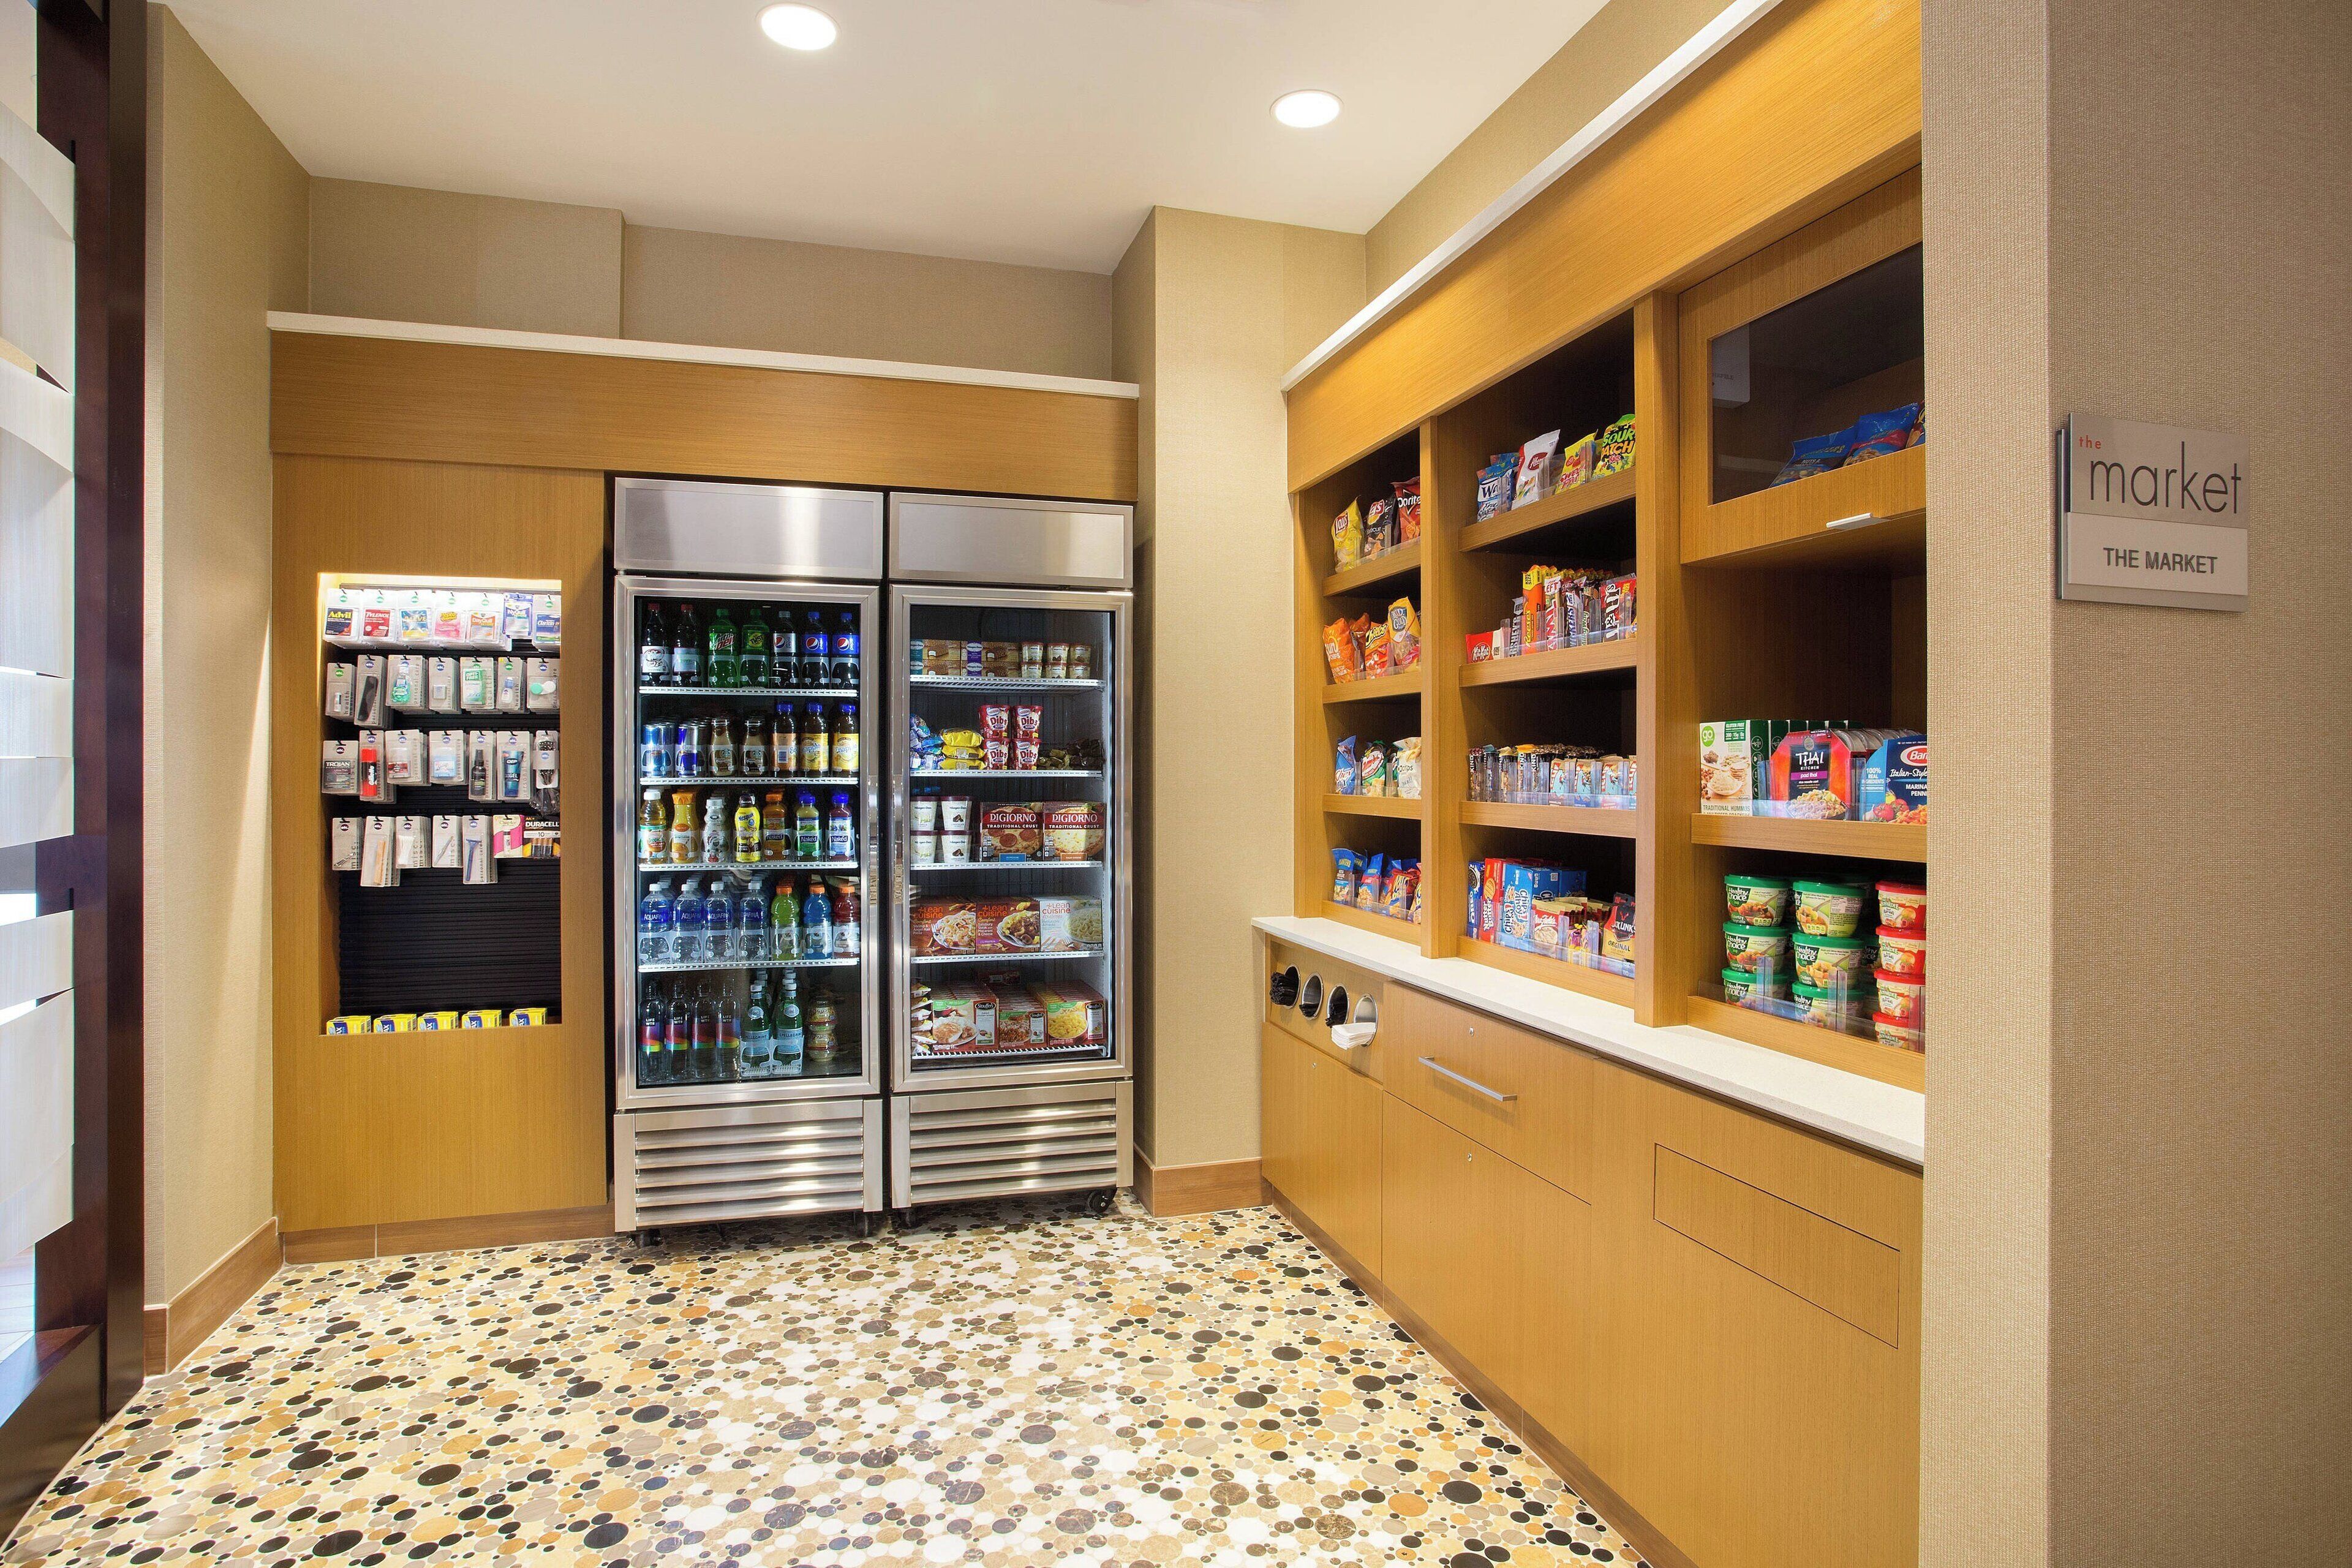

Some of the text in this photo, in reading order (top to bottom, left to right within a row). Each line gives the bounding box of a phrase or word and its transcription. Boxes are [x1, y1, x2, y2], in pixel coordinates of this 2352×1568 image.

[1603, 428, 1635, 447] SOUR
[2079, 435, 2101, 449] the
[2090, 441, 2241, 514] market
[1397, 495, 1421, 508] Dorito
[2103, 548, 2218, 575] THE MARKET
[1547, 581, 1559, 592] EFT
[990, 715, 1008, 726] Dibs
[1021, 716, 1038, 726] Dibs
[1703, 730, 1713, 742] go
[990, 749, 1008, 759] Dibs
[1020, 750, 1037, 760] Dibs
[1795, 751, 1823, 766] THAI
[1728, 892, 1747, 901] Choice
[1727, 941, 1746, 950] Choice
[1796, 946, 1817, 956] Healthy
[1796, 952, 1815, 961] Choice
[1727, 982, 1747, 991] Healthy
[1795, 994, 1811, 1005] Healthy
